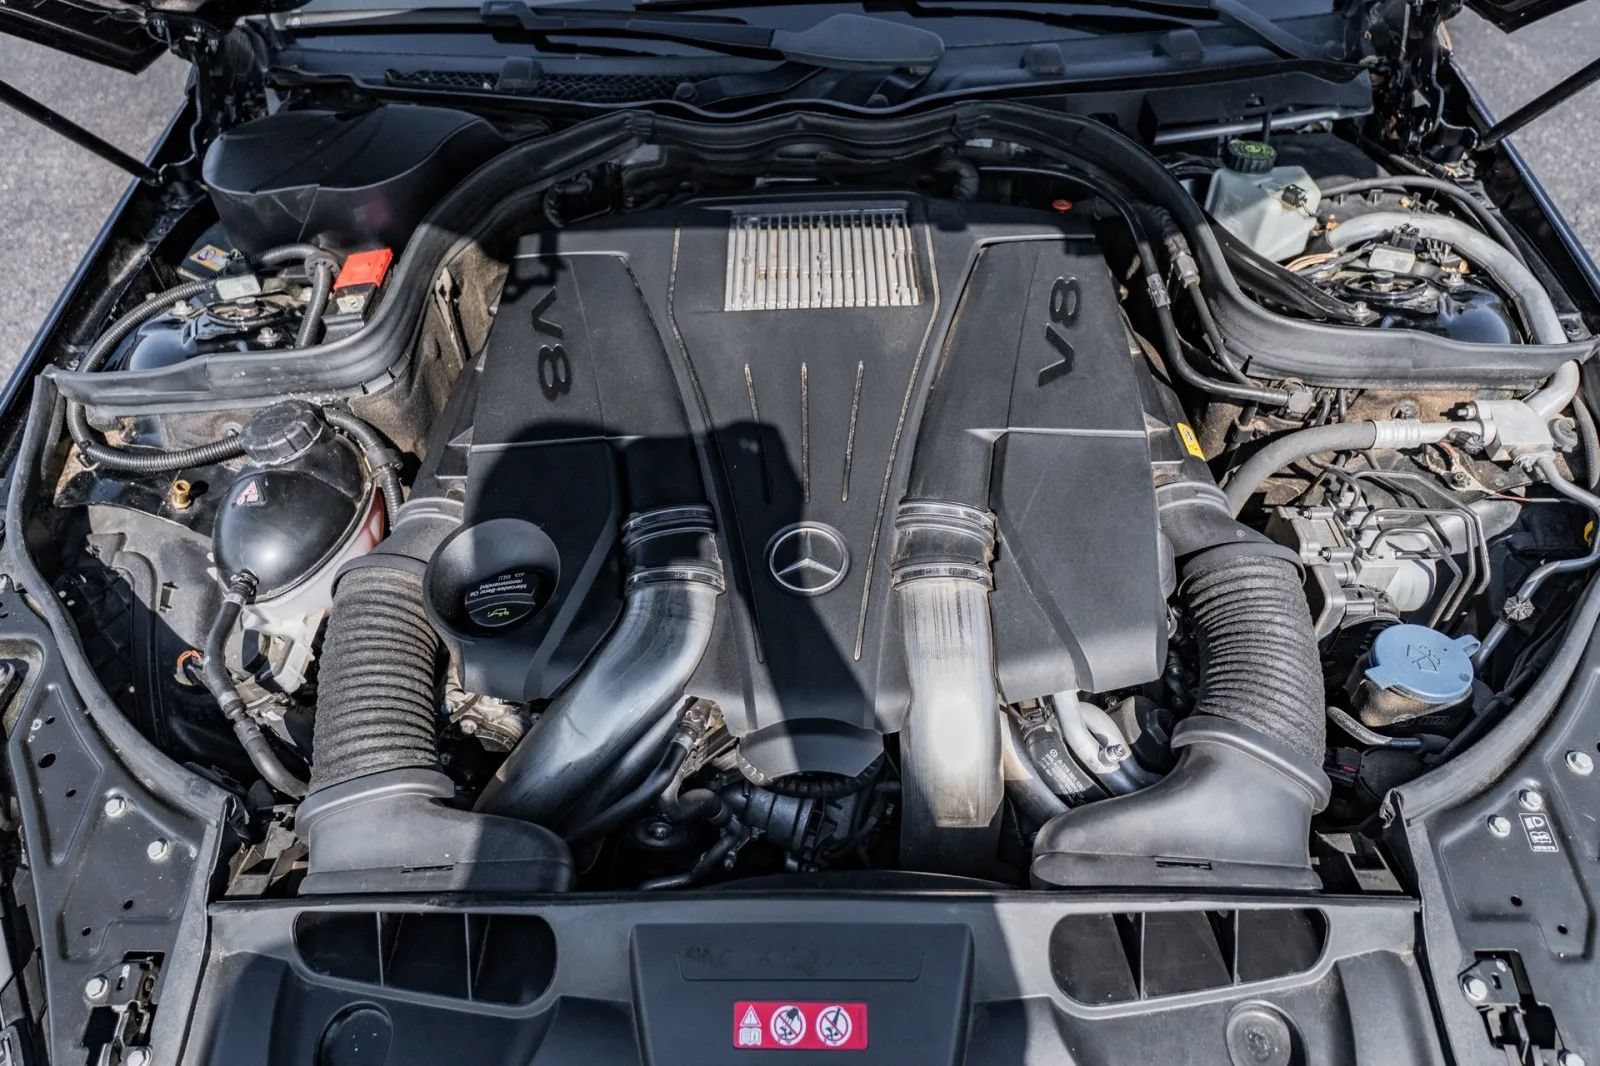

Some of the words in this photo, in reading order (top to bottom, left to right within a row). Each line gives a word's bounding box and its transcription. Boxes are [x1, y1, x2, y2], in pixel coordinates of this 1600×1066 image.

[531, 285, 572, 401] V8
[1038, 276, 1081, 387] V8
[479, 579, 523, 590] recommended
[480, 584, 527, 595] Mercedes-Benz
